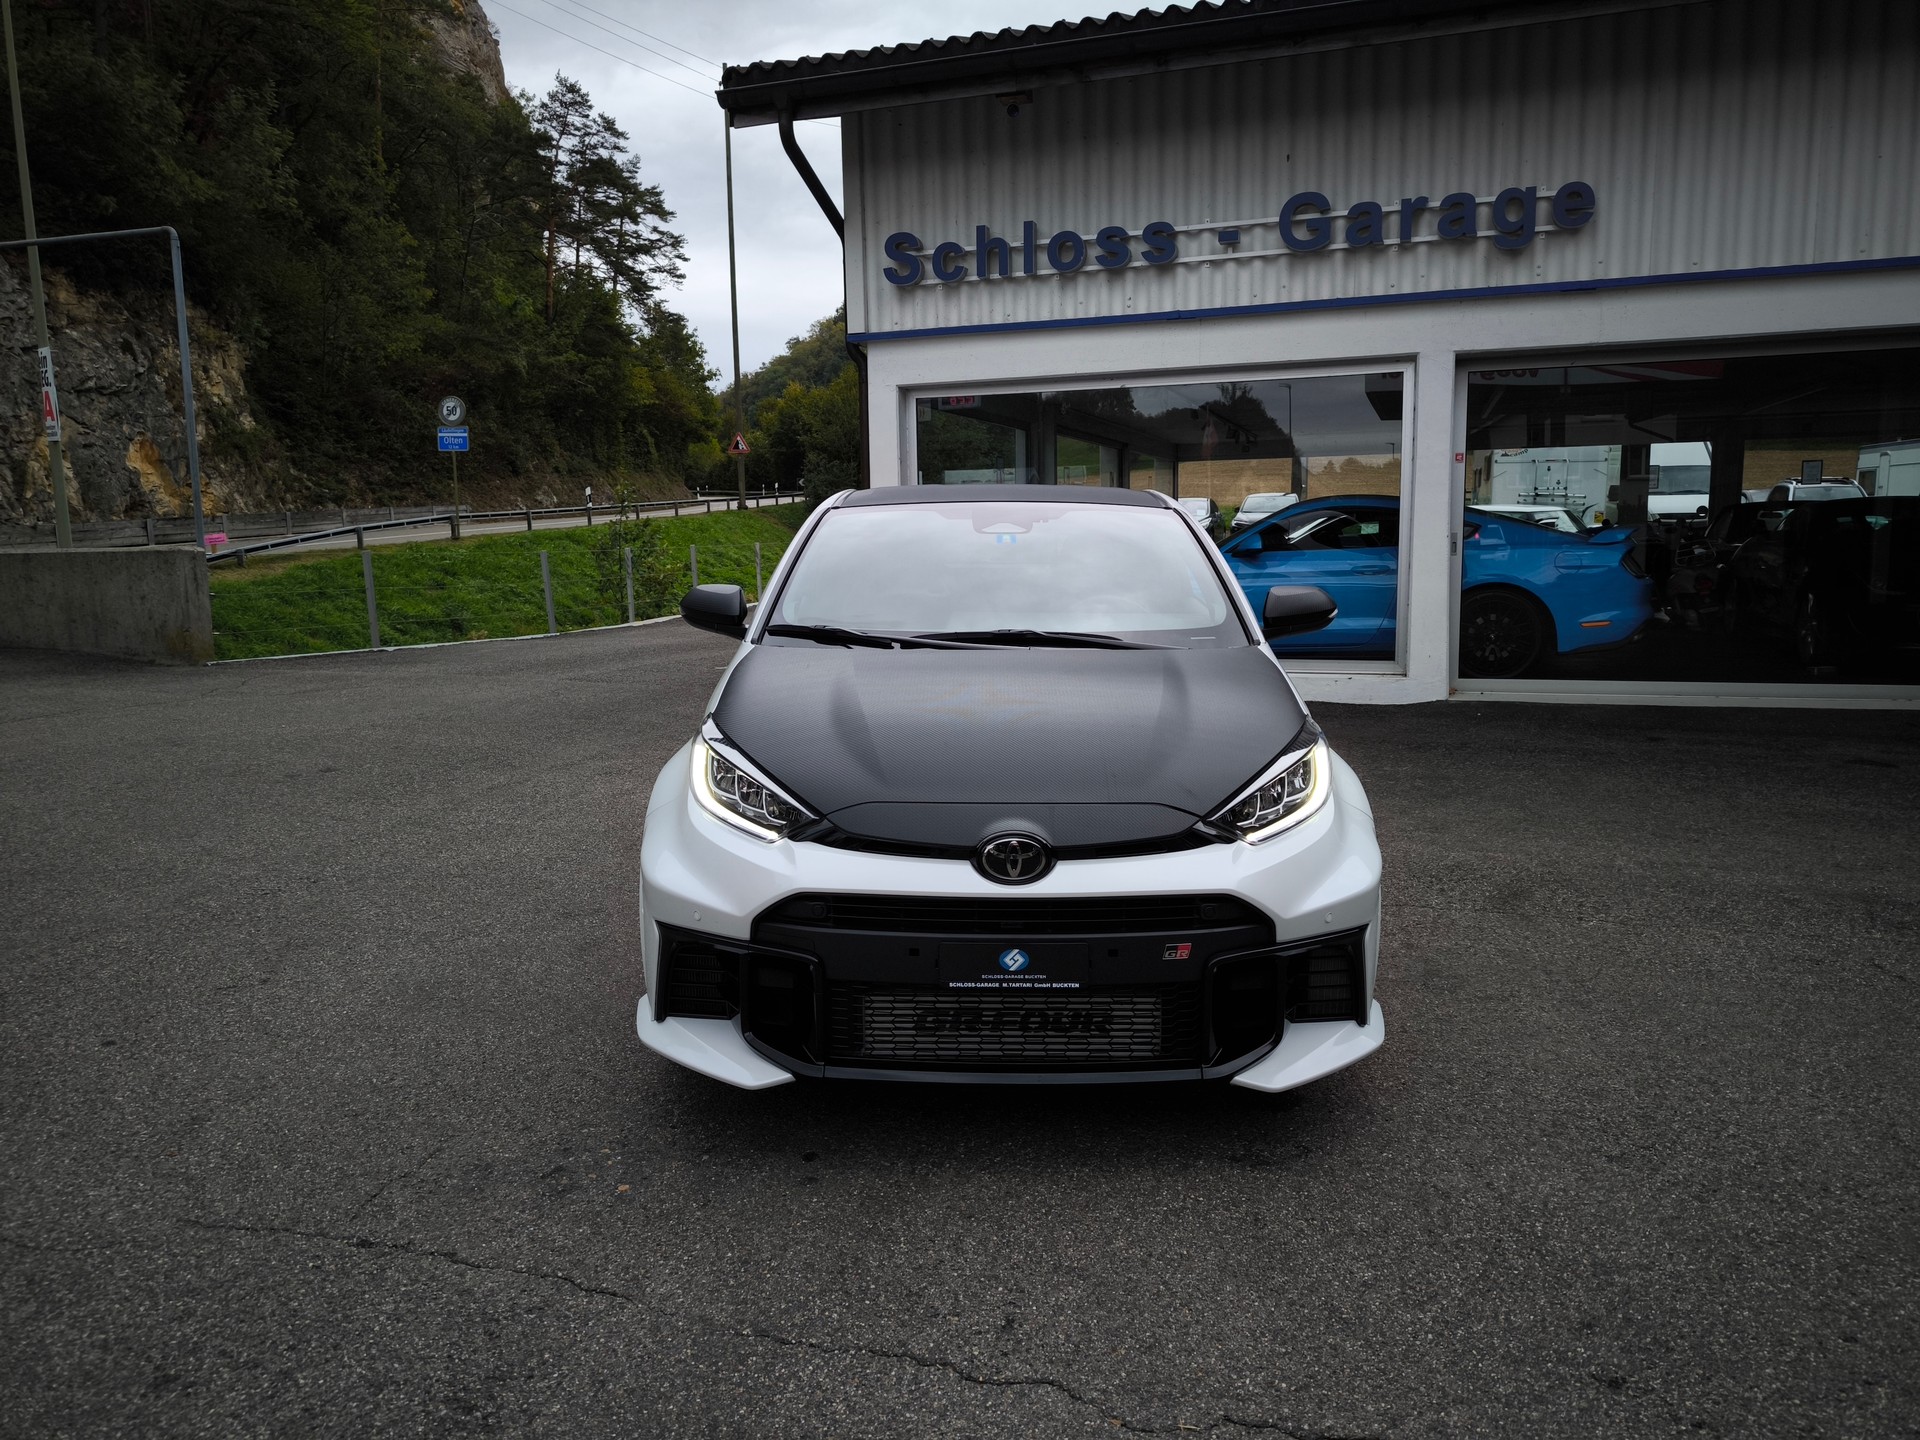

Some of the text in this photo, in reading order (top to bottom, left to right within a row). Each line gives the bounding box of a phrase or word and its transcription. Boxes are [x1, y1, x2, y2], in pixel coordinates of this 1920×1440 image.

[882, 219, 1179, 287] Schloss
[1278, 180, 1597, 252] Garage
[446, 405, 457, 416] 50
[443, 436, 463, 444] Olten
